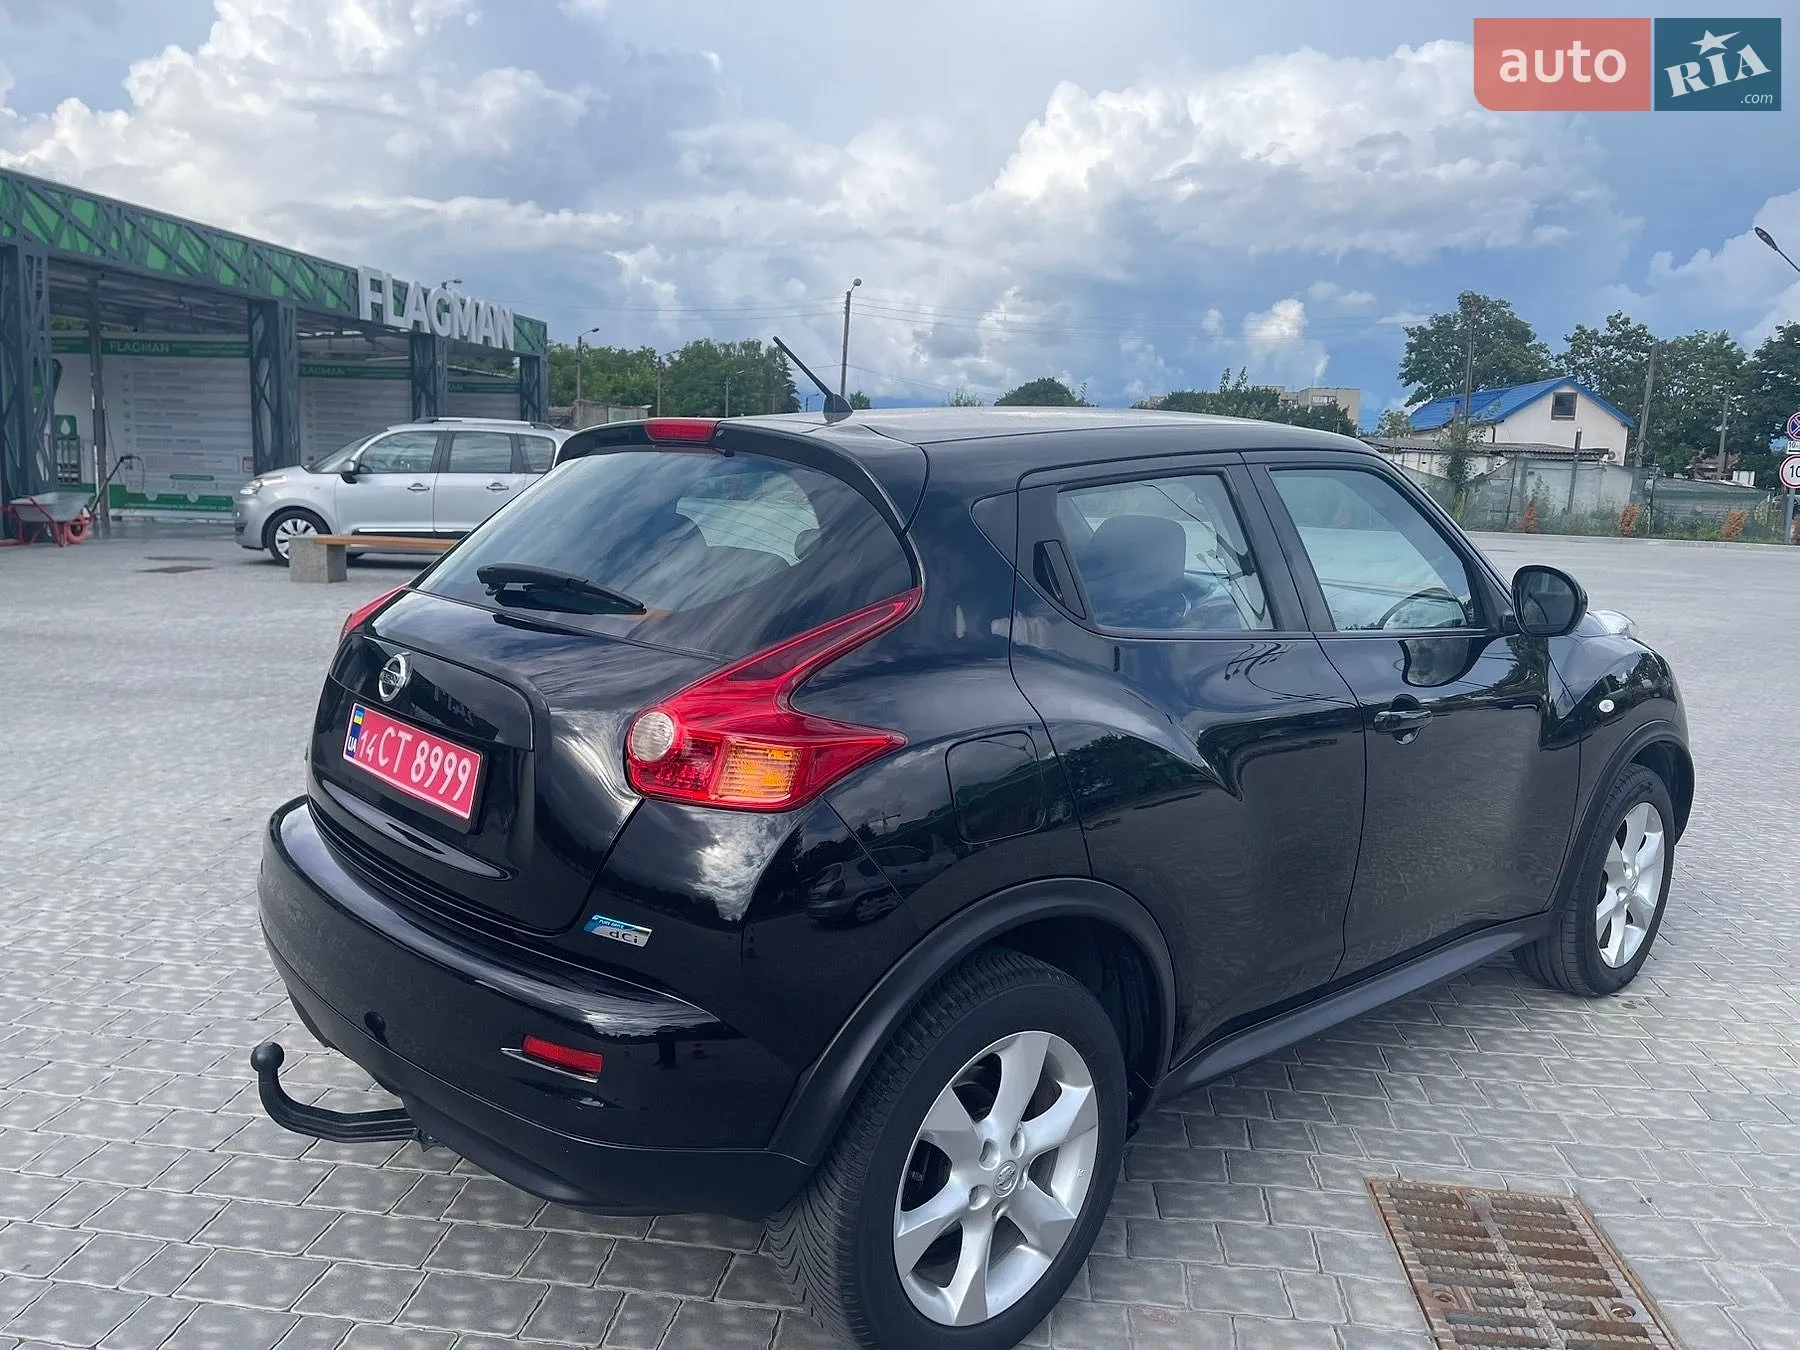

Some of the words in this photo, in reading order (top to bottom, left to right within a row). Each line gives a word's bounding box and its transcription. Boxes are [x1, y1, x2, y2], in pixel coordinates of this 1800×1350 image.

[357, 265, 515, 351] FLAGMAN
[110, 340, 170, 353] FLAGMAN
[347, 735, 358, 753] UA
[410, 740, 472, 801] 8999
